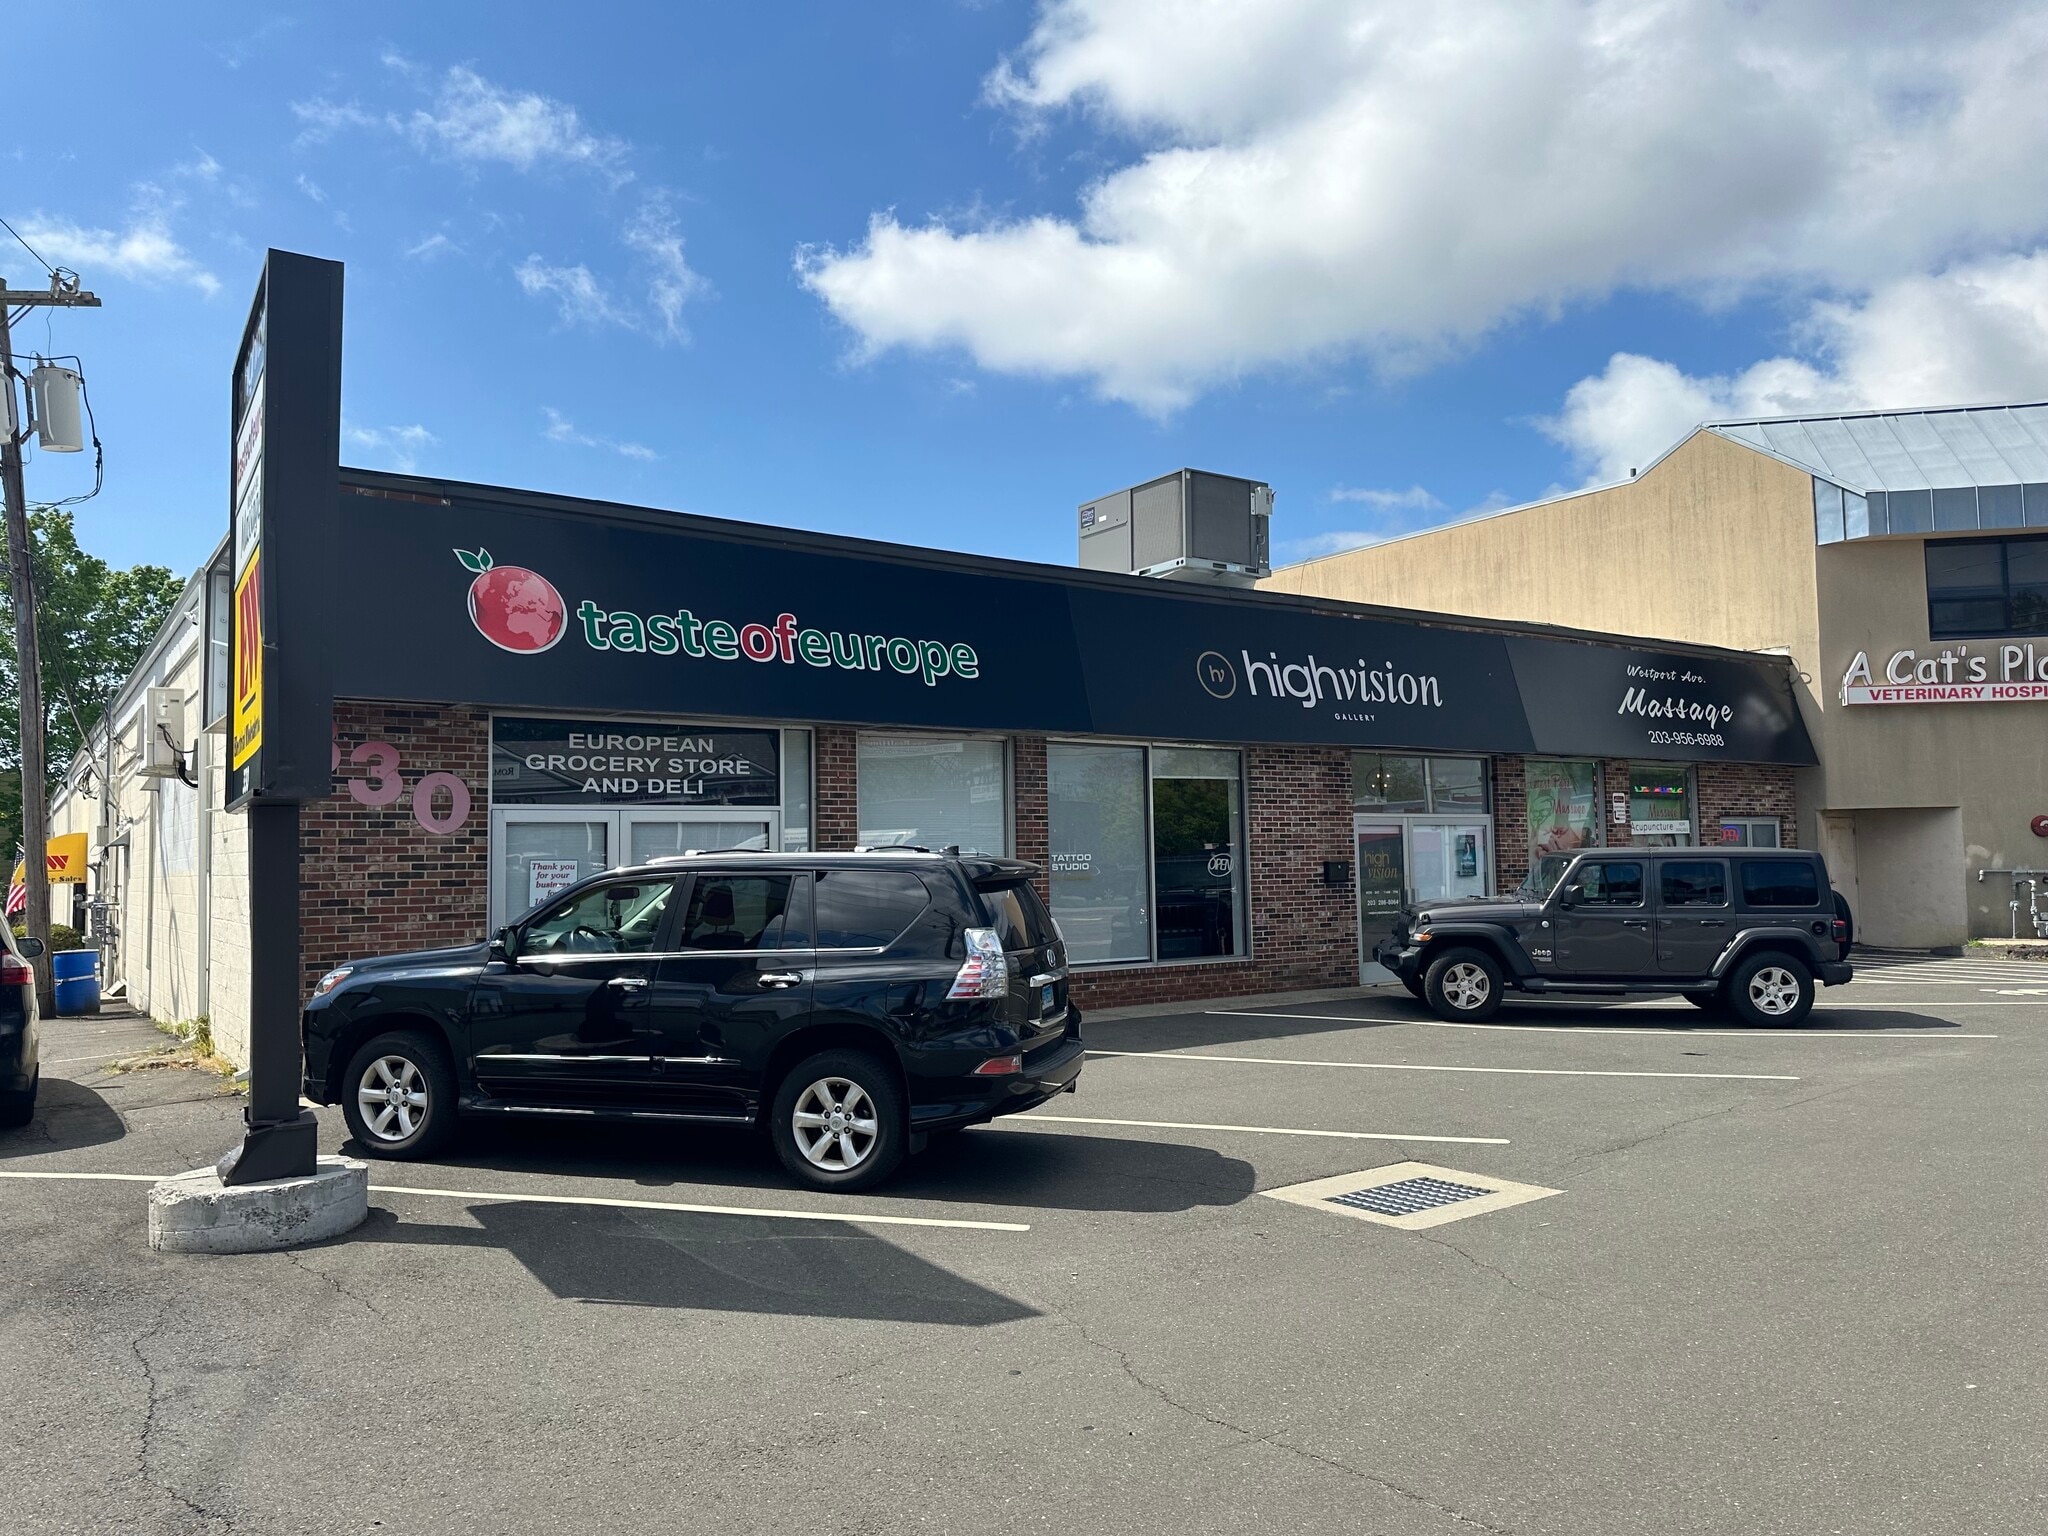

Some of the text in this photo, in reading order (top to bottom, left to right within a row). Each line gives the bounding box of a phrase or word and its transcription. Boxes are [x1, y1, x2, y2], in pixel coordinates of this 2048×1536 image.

[577, 600, 980, 686] tasteofeurope
[1845, 651, 1874, 686] A
[1886, 645, 1988, 685] Cat's
[1241, 650, 1443, 708] highvision
[1627, 664, 1707, 684] Westport Ave.
[1869, 686, 1985, 701] VETERINARY
[1617, 686, 1734, 730] Massage
[1334, 713, 1376, 722] GALLERY
[568, 733, 714, 754] EUROPEAN
[1648, 730, 1725, 747] 203-956-6988
[525, 754, 750, 775] GROCERY STORE
[332, 719, 471, 834] 30
[581, 777, 639, 793] AND
[647, 779, 704, 795] DELI
[1632, 821, 1674, 832] Acupuncture
[1051, 853, 1092, 862] TATTOO
[1209, 857, 1233, 871] OPEN
[1364, 850, 1390, 865] high
[532, 862, 576, 872] Thank you
[1051, 862, 1090, 871] STUDIO
[1368, 864, 1397, 879] vision
[536, 872, 549, 880] for
[1531, 948, 1552, 957] Jeep
